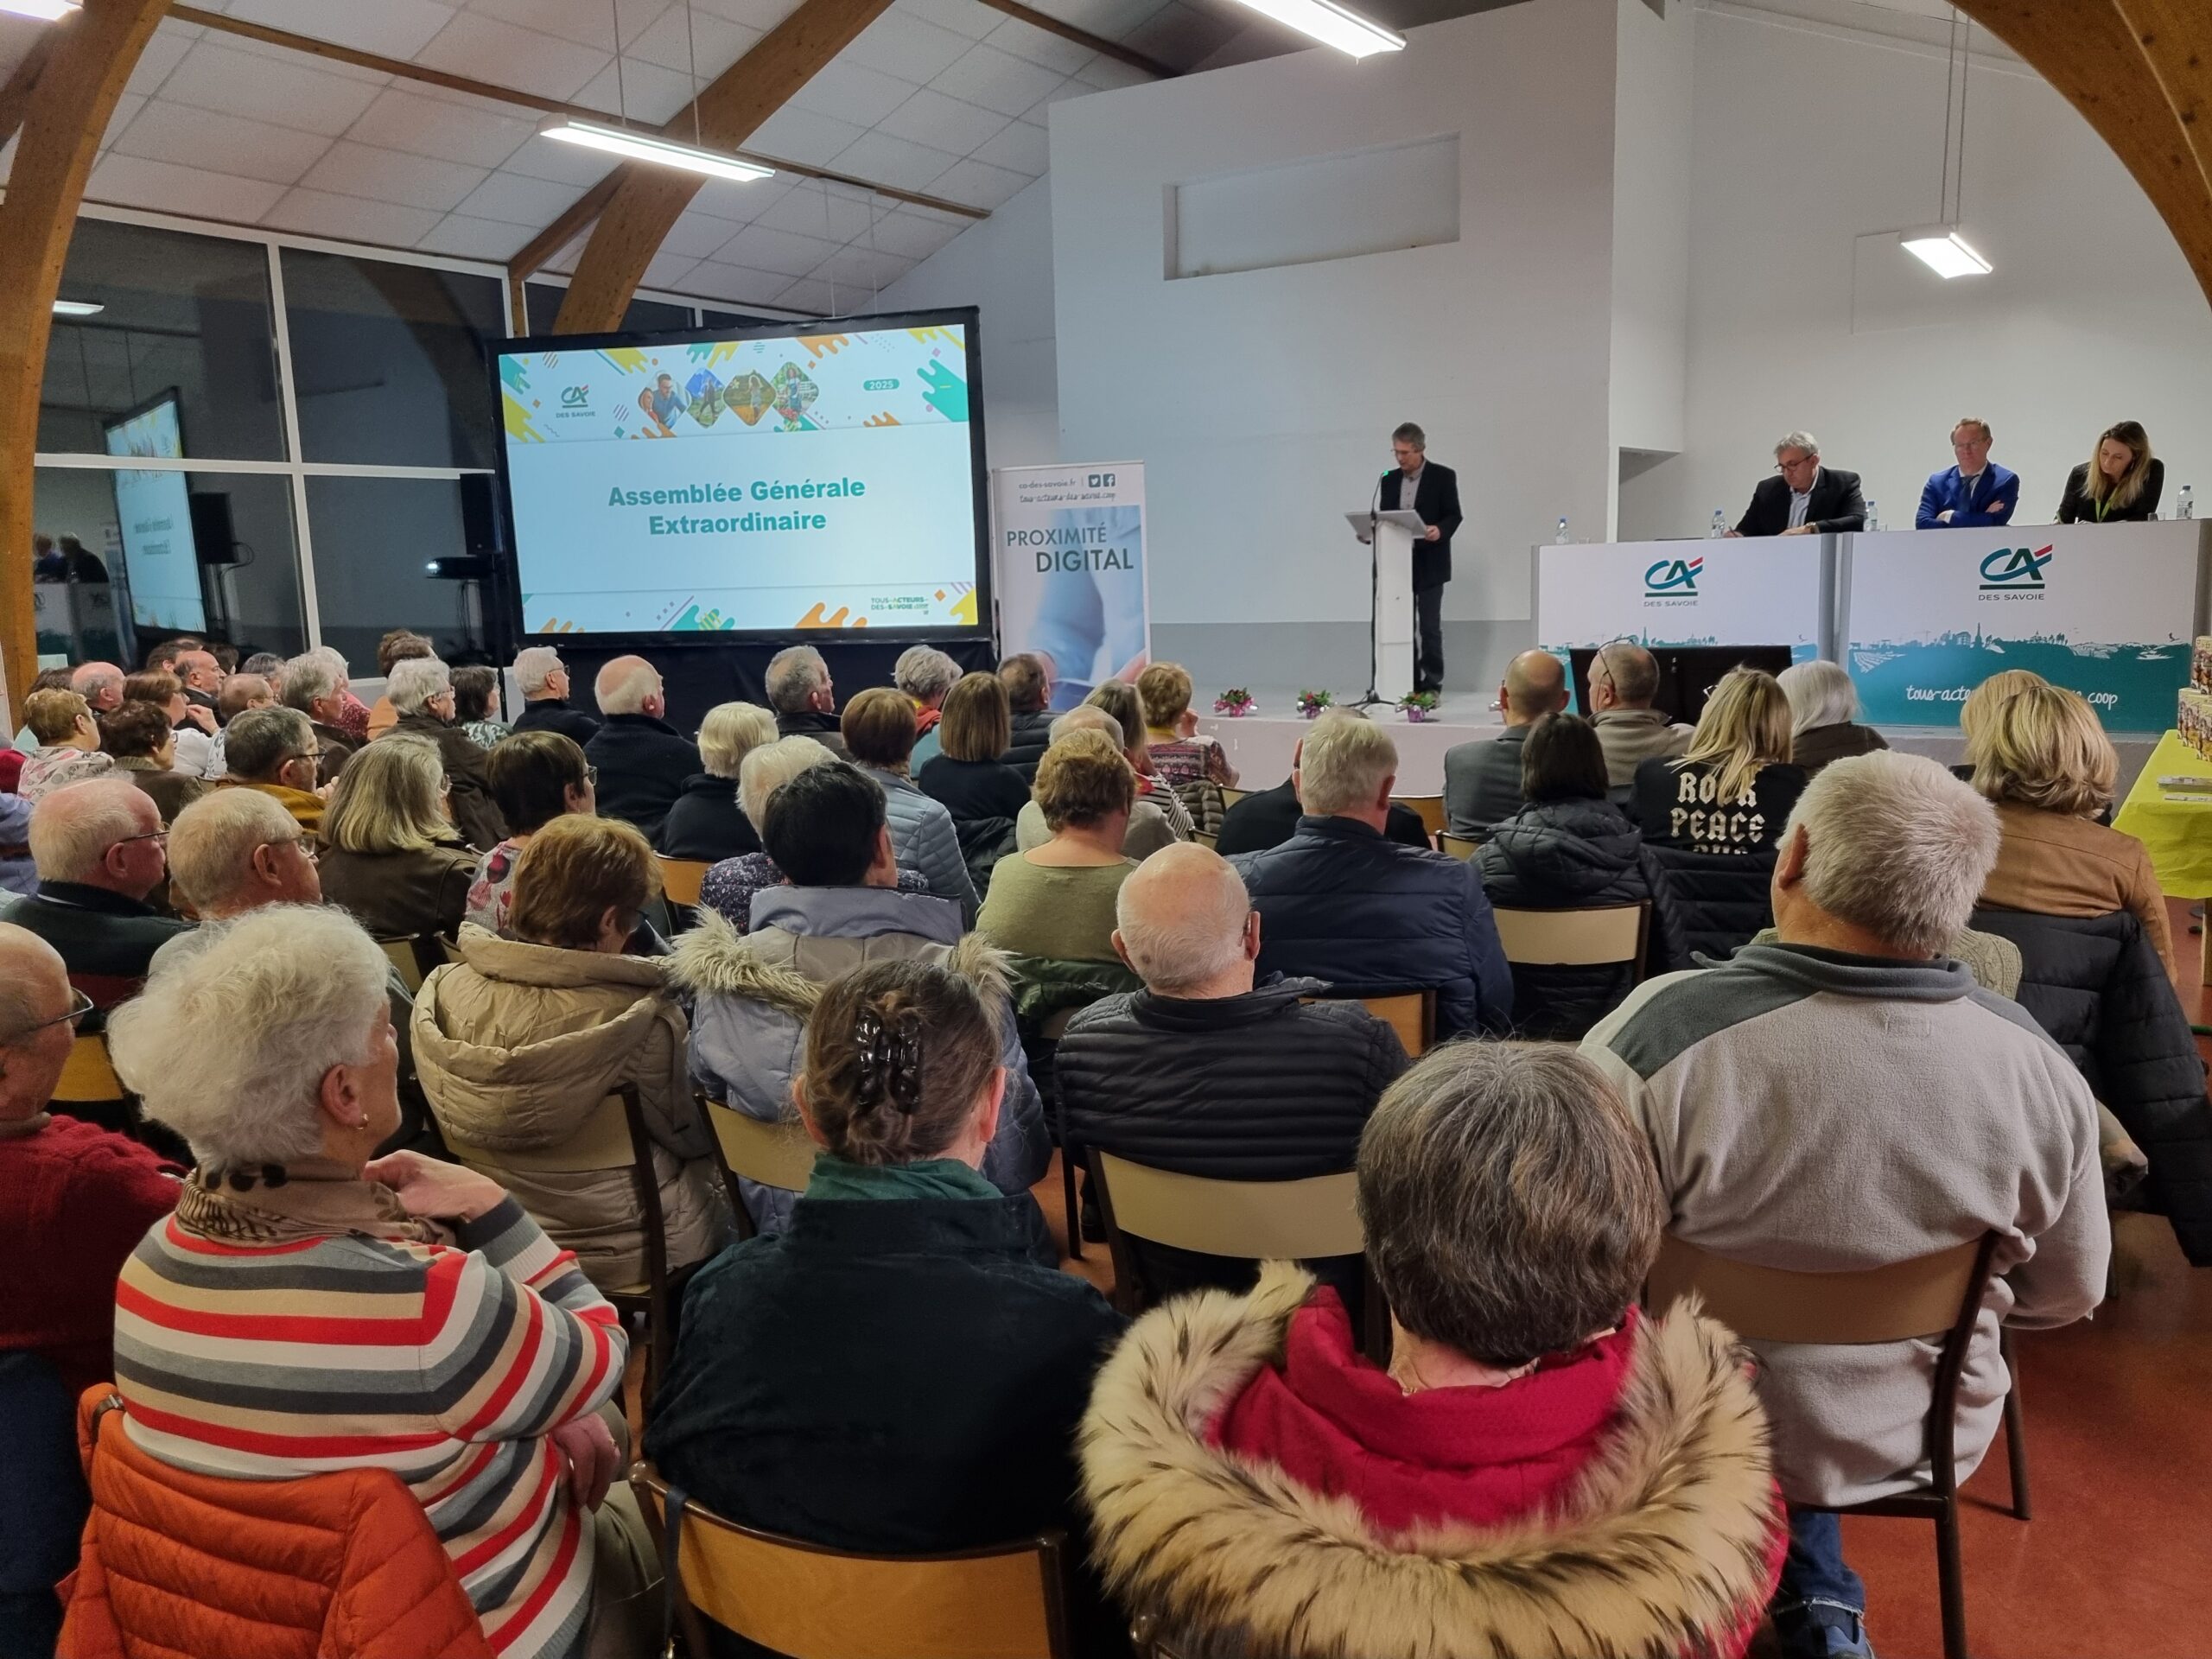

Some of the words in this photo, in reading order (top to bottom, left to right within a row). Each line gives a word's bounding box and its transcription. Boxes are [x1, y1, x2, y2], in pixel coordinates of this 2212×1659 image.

[869, 380, 894, 390] 2025
[608, 482, 742, 506] Assemblée
[750, 477, 866, 501] Générale
[649, 511, 826, 535] Extraordinaire
[1007, 522, 1107, 547] PROXIMITÉ
[1036, 548, 1135, 573] DIGITAL
[1644, 556, 1704, 590] CA
[1980, 543, 2053, 582] CA
[1906, 684, 1973, 702] tous-acte
[1677, 772, 1758, 808] ROK
[1670, 807, 1765, 843] PEACE
